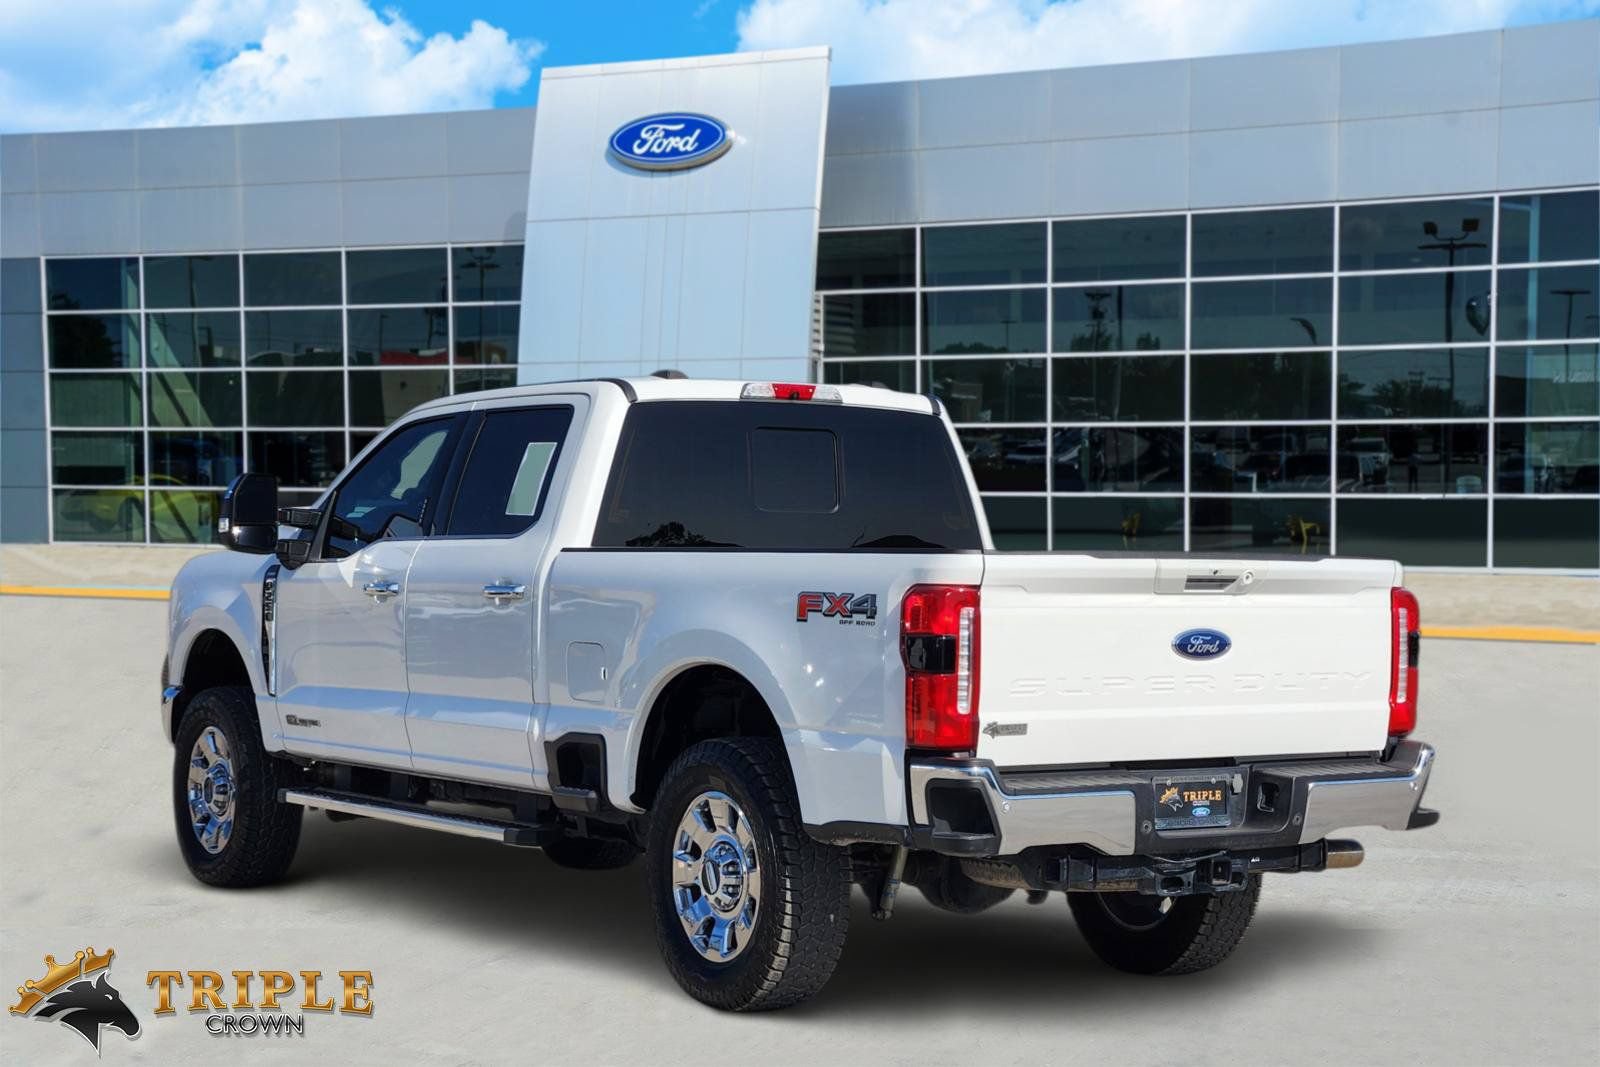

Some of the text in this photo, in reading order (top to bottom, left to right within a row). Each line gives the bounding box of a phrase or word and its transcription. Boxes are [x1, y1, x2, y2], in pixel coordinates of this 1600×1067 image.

[632, 123, 701, 155] Ford
[796, 591, 877, 622] FX4
[1187, 635, 1220, 653] Ford
[1008, 671, 1372, 697] SUPER DUTY
[1183, 790, 1222, 802] TRIPLE
